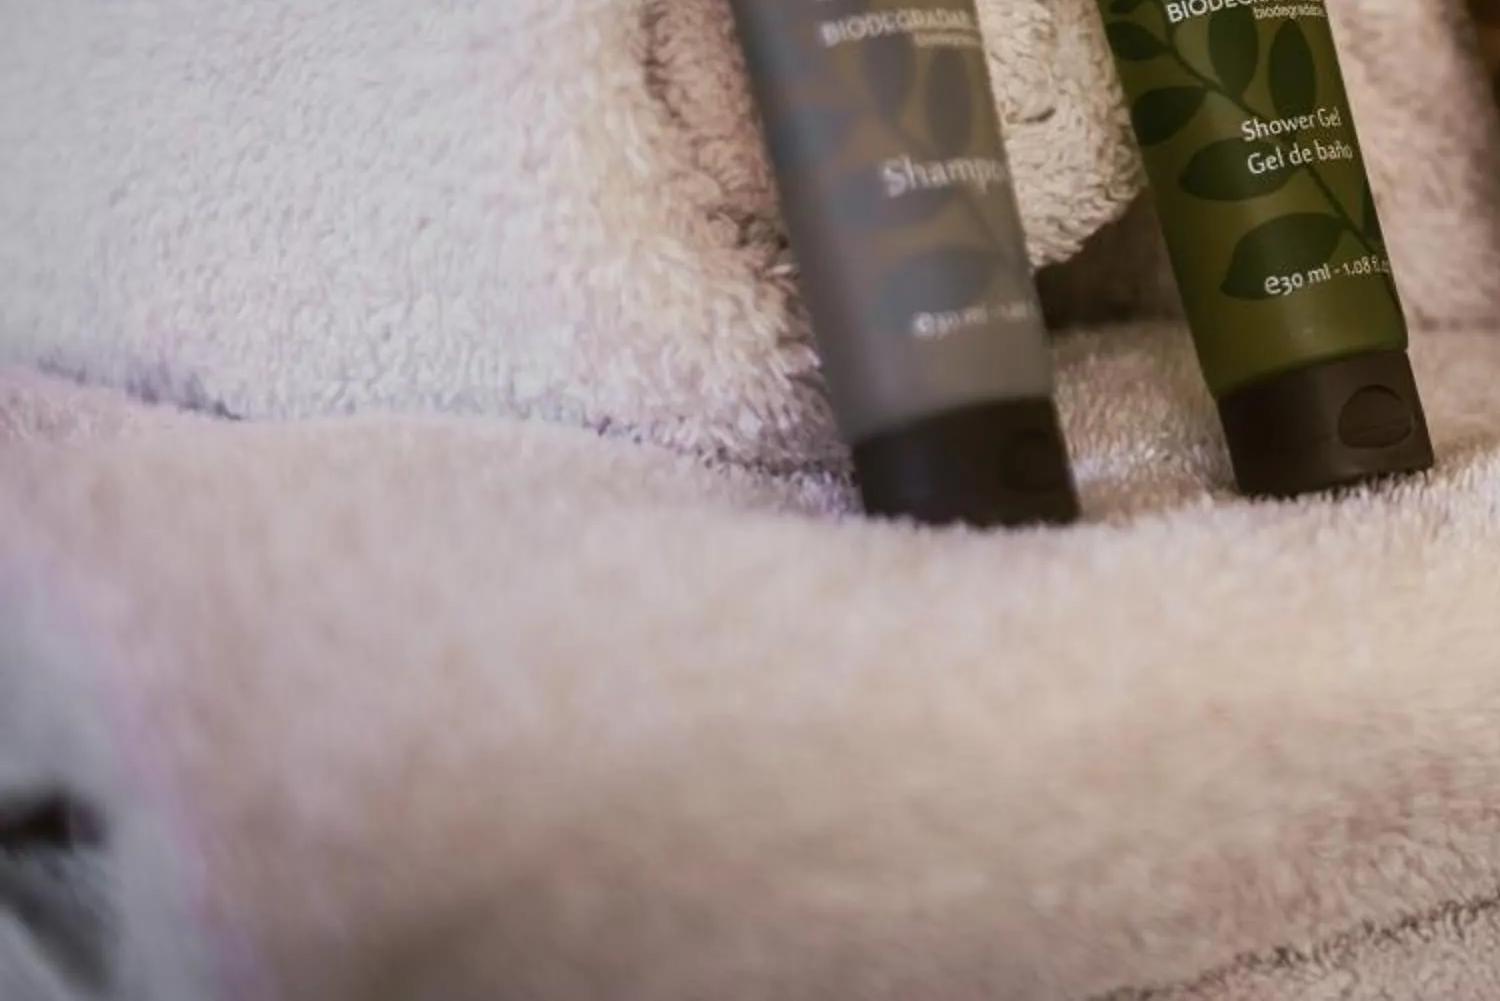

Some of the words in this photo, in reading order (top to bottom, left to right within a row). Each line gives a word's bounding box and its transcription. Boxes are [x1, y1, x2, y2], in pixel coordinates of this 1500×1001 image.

[1241, 111, 1315, 142] Shower
[1317, 106, 1342, 128] Gel
[1247, 146, 1285, 174] Gel
[1289, 143, 1313, 166] de
[1307, 262, 1332, 285] ml
